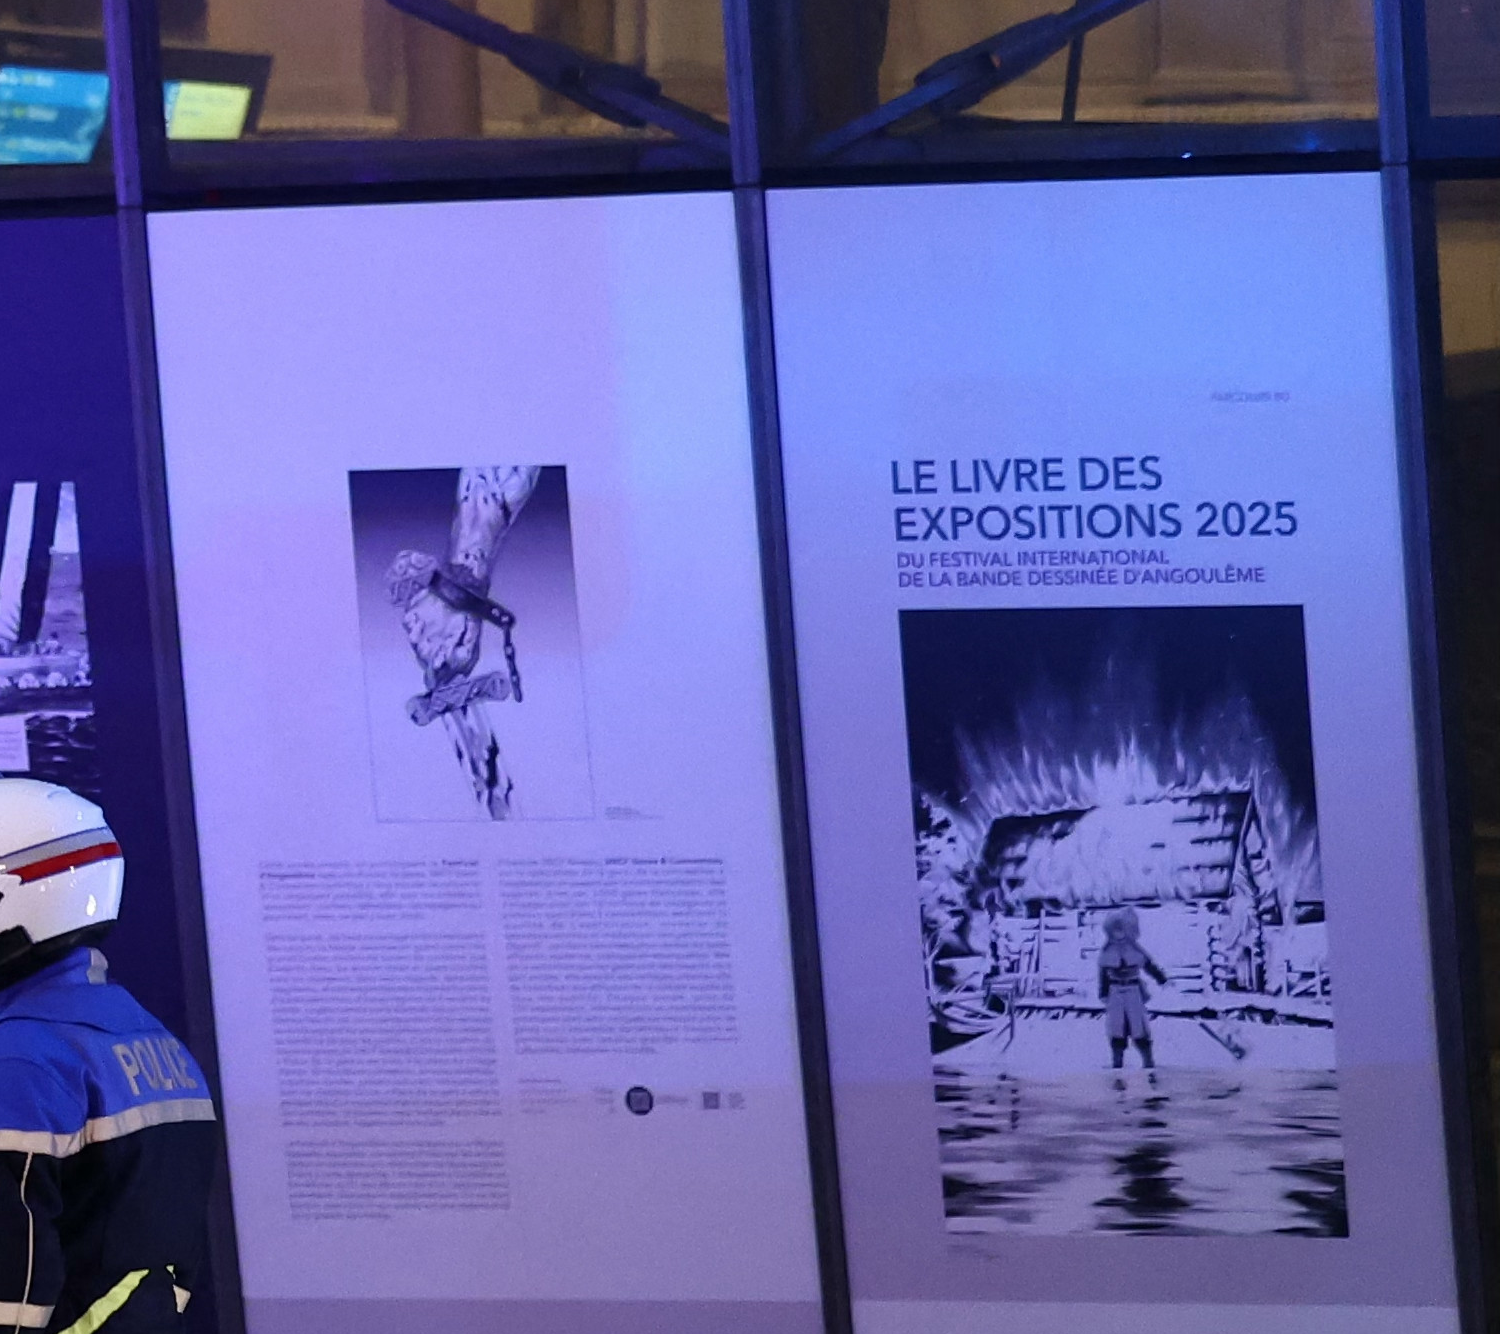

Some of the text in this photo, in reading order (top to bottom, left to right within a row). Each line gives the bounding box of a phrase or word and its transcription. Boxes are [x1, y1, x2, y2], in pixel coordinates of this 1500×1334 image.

[891, 455, 1163, 495] LE LIVRE DES
[894, 500, 1298, 542] EXPOSITIONS 2025
[897, 548, 1170, 569] DU FESTIVAL INTERNATIONAL
[899, 563, 1266, 588] DE LA BANDE DESSINÉE D'ANGOULÊME
[111, 1037, 198, 1097] POLICE
